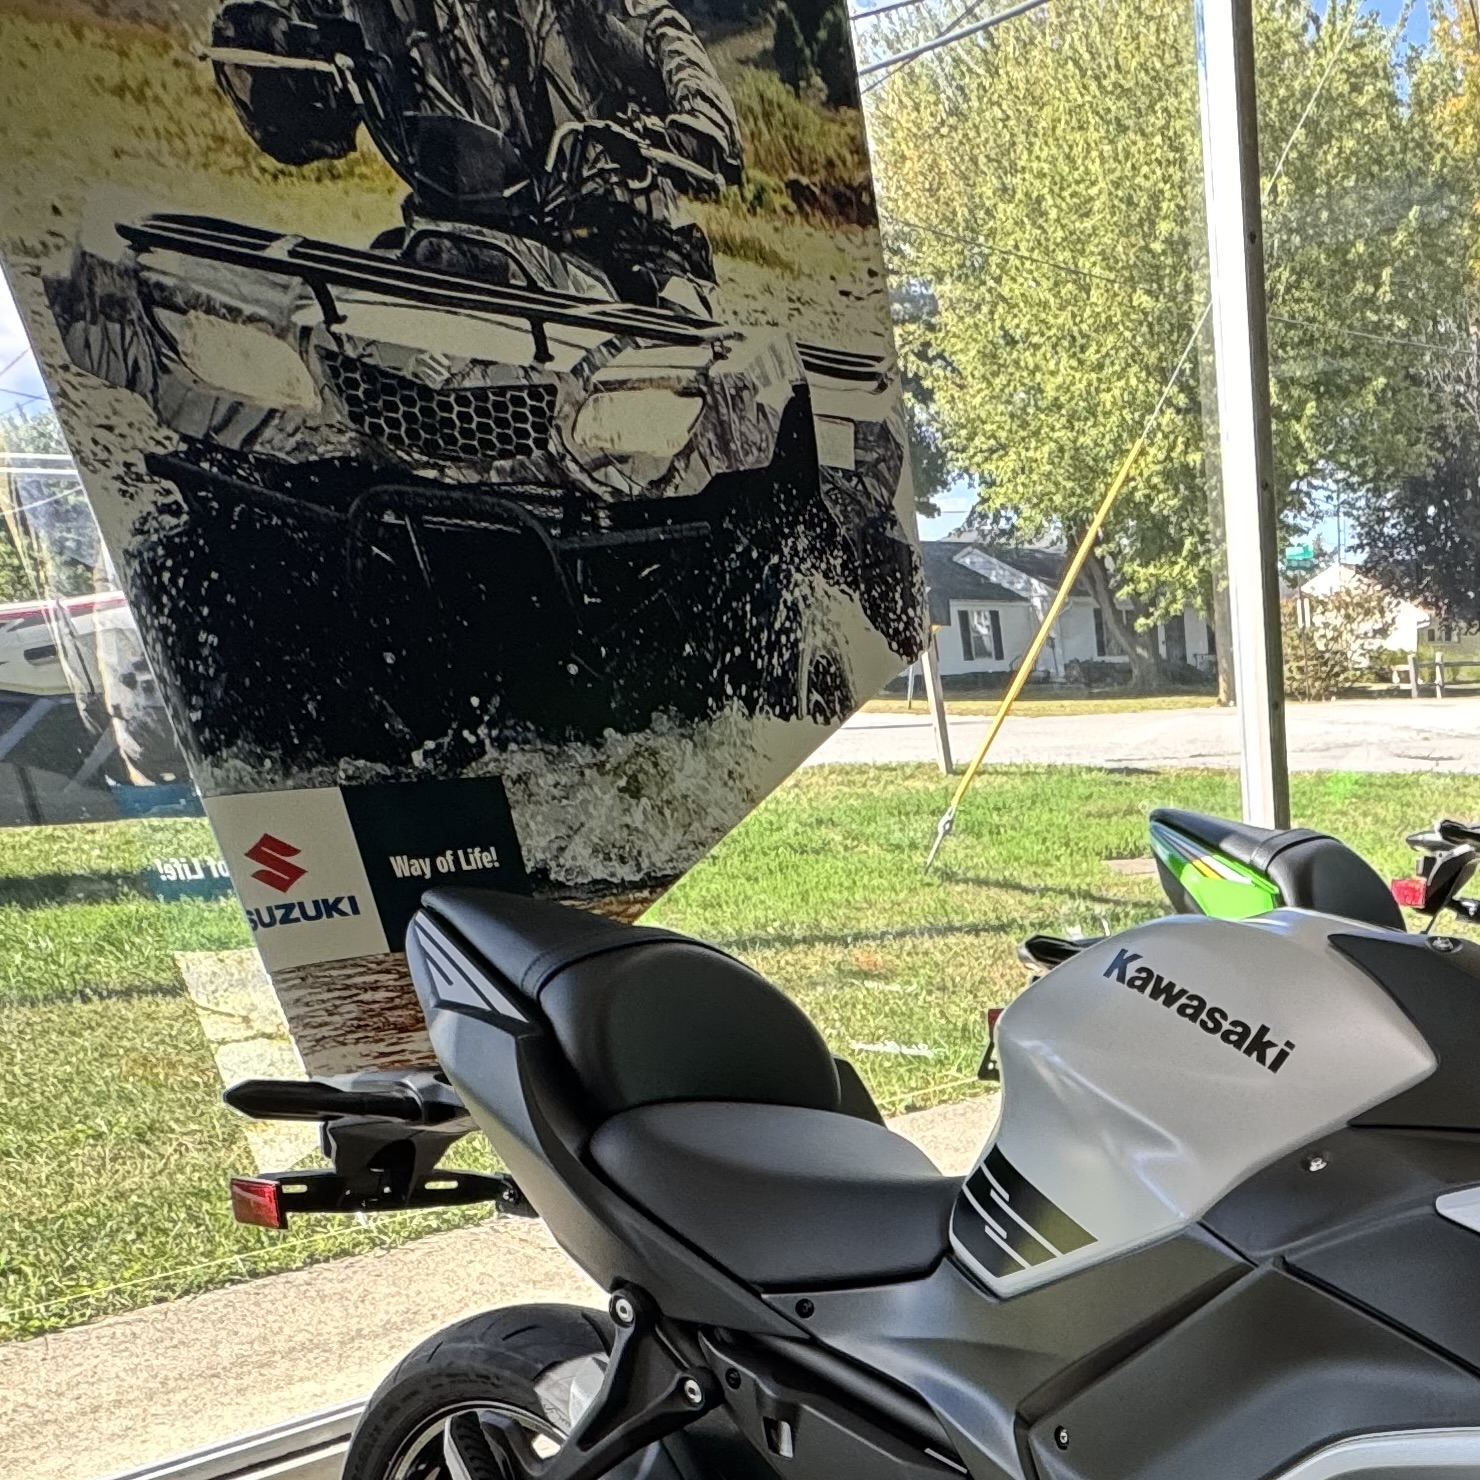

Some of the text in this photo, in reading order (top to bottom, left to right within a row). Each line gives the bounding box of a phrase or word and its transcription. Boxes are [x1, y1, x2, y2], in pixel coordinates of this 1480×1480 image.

[389, 846, 500, 880] Way of Life!
[246, 895, 361, 932] SUZUKI
[1102, 948, 1297, 1075] Kawasaki
